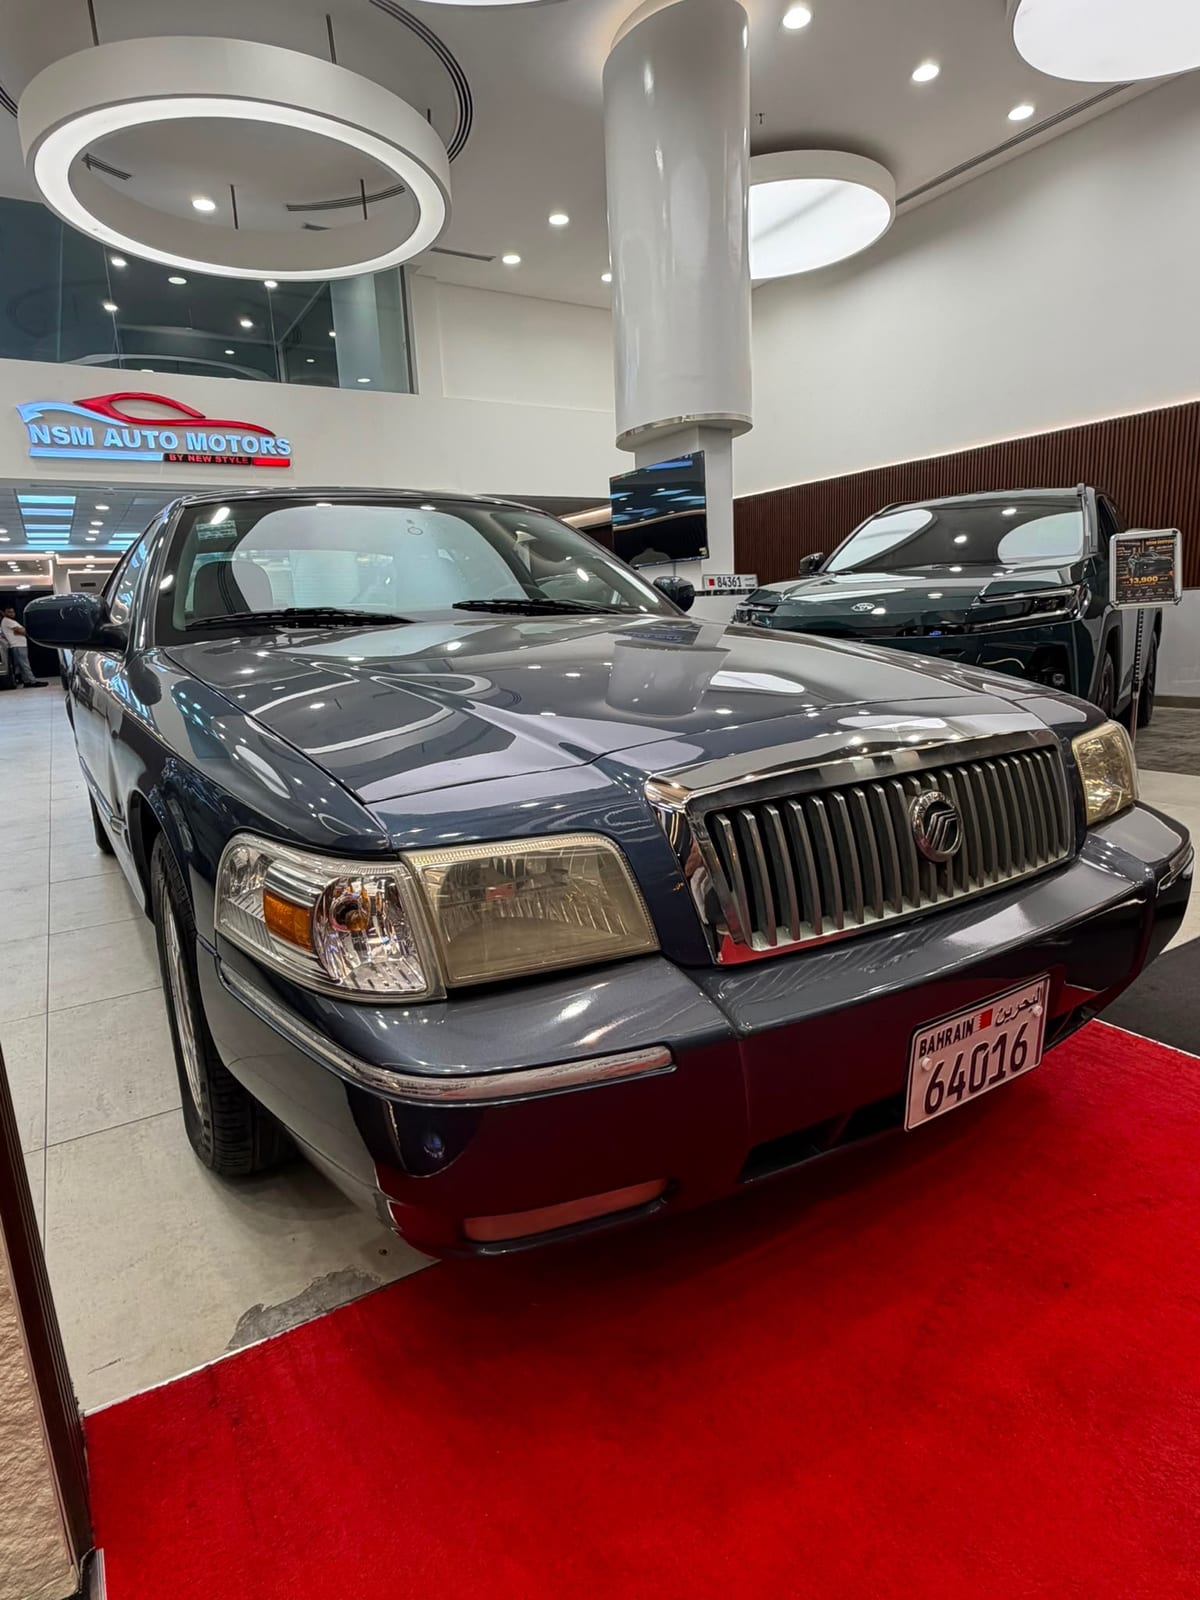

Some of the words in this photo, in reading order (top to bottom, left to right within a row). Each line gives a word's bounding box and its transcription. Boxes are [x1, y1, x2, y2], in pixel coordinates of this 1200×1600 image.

[30, 424, 94, 446] NSM
[103, 427, 178, 450] AUTO
[187, 432, 291, 456] MOTORS
[168, 453, 184, 462] BY
[187, 454, 212, 463] NEW
[215, 455, 249, 465] STYLE
[717, 576, 742, 588] 84361
[919, 1017, 975, 1059] BAHRAIN
[924, 1022, 1029, 1115] 64016
